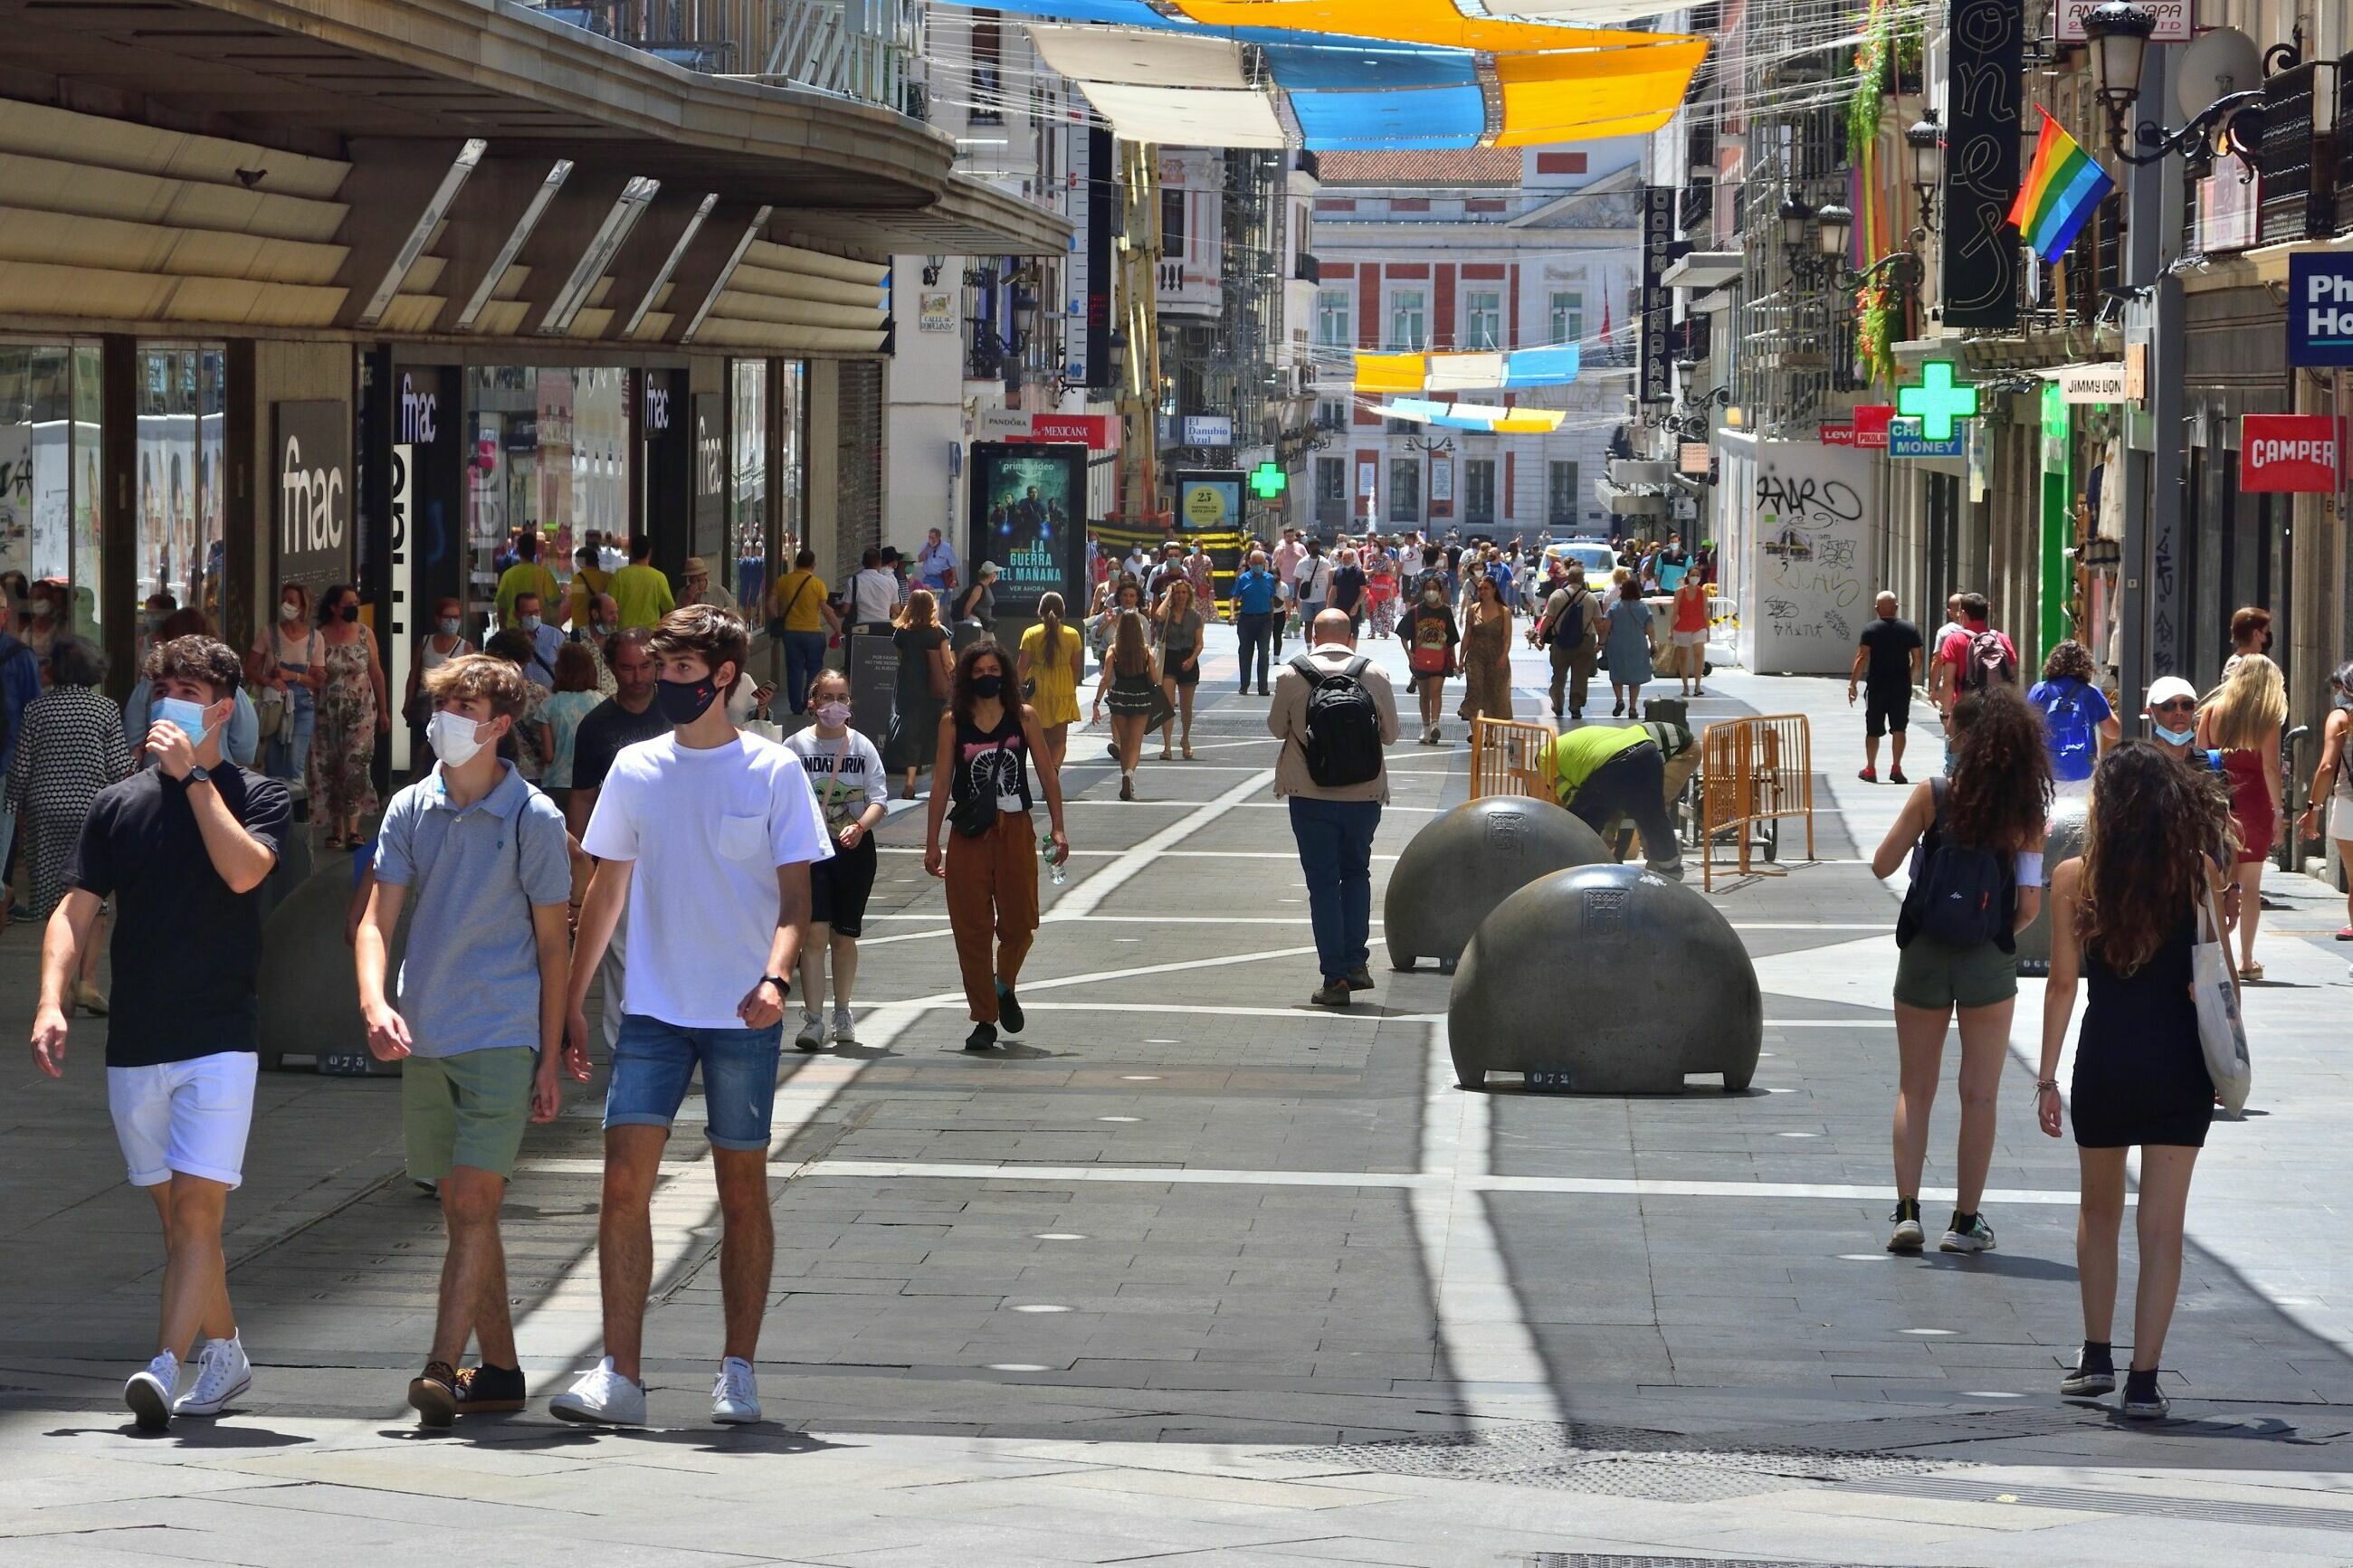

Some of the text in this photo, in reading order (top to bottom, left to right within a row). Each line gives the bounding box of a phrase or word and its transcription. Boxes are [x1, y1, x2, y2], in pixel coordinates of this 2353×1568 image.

[1647, 188, 1670, 401] SPORT 2000
[646, 372, 670, 429] fnac
[403, 372, 436, 443] fnac
[1188, 417, 1199, 426] El
[1044, 425, 1088, 436] MEXICANA
[1188, 426, 1228, 435] Danubio
[1891, 425, 1960, 437] CHAE
[1188, 435, 1211, 444] Azul
[1896, 441, 1956, 452] MONEY
[698, 414, 722, 497] fnac
[2251, 439, 2335, 469] CAMPER
[282, 434, 344, 555] fnac
[1032, 540, 1045, 553] LA
[1010, 553, 1053, 566] GUERRA
[1015, 565, 1062, 582] MAÑANA
[1533, 1072, 1568, 1084] 072
